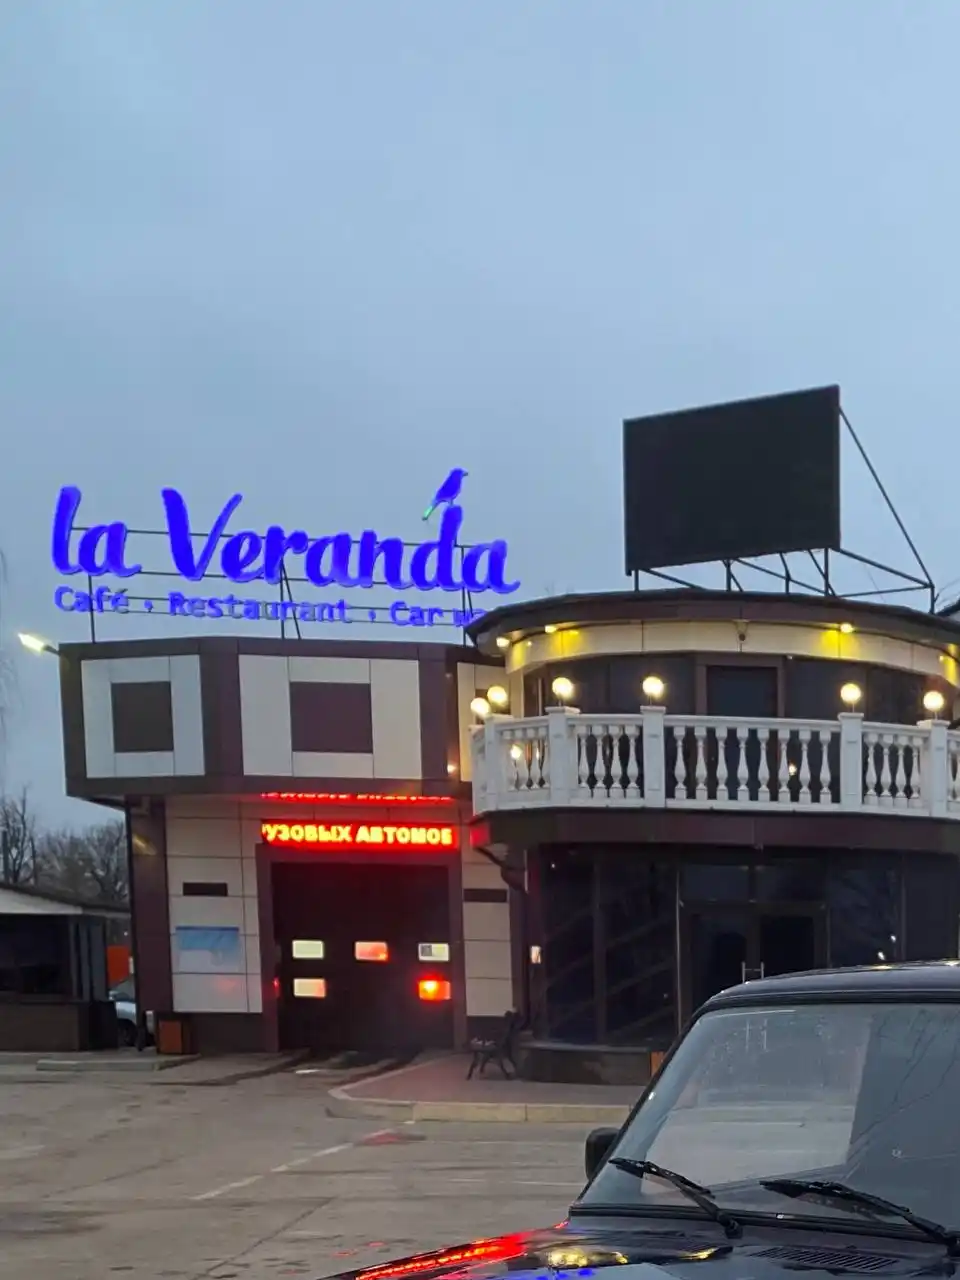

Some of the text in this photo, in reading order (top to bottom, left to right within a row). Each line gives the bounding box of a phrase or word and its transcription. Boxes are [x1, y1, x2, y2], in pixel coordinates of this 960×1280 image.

[162, 487, 521, 593] Veranda
[54, 586, 129, 614] Café
[168, 591, 353, 624] Restaurant
[389, 600, 444, 627] Car
